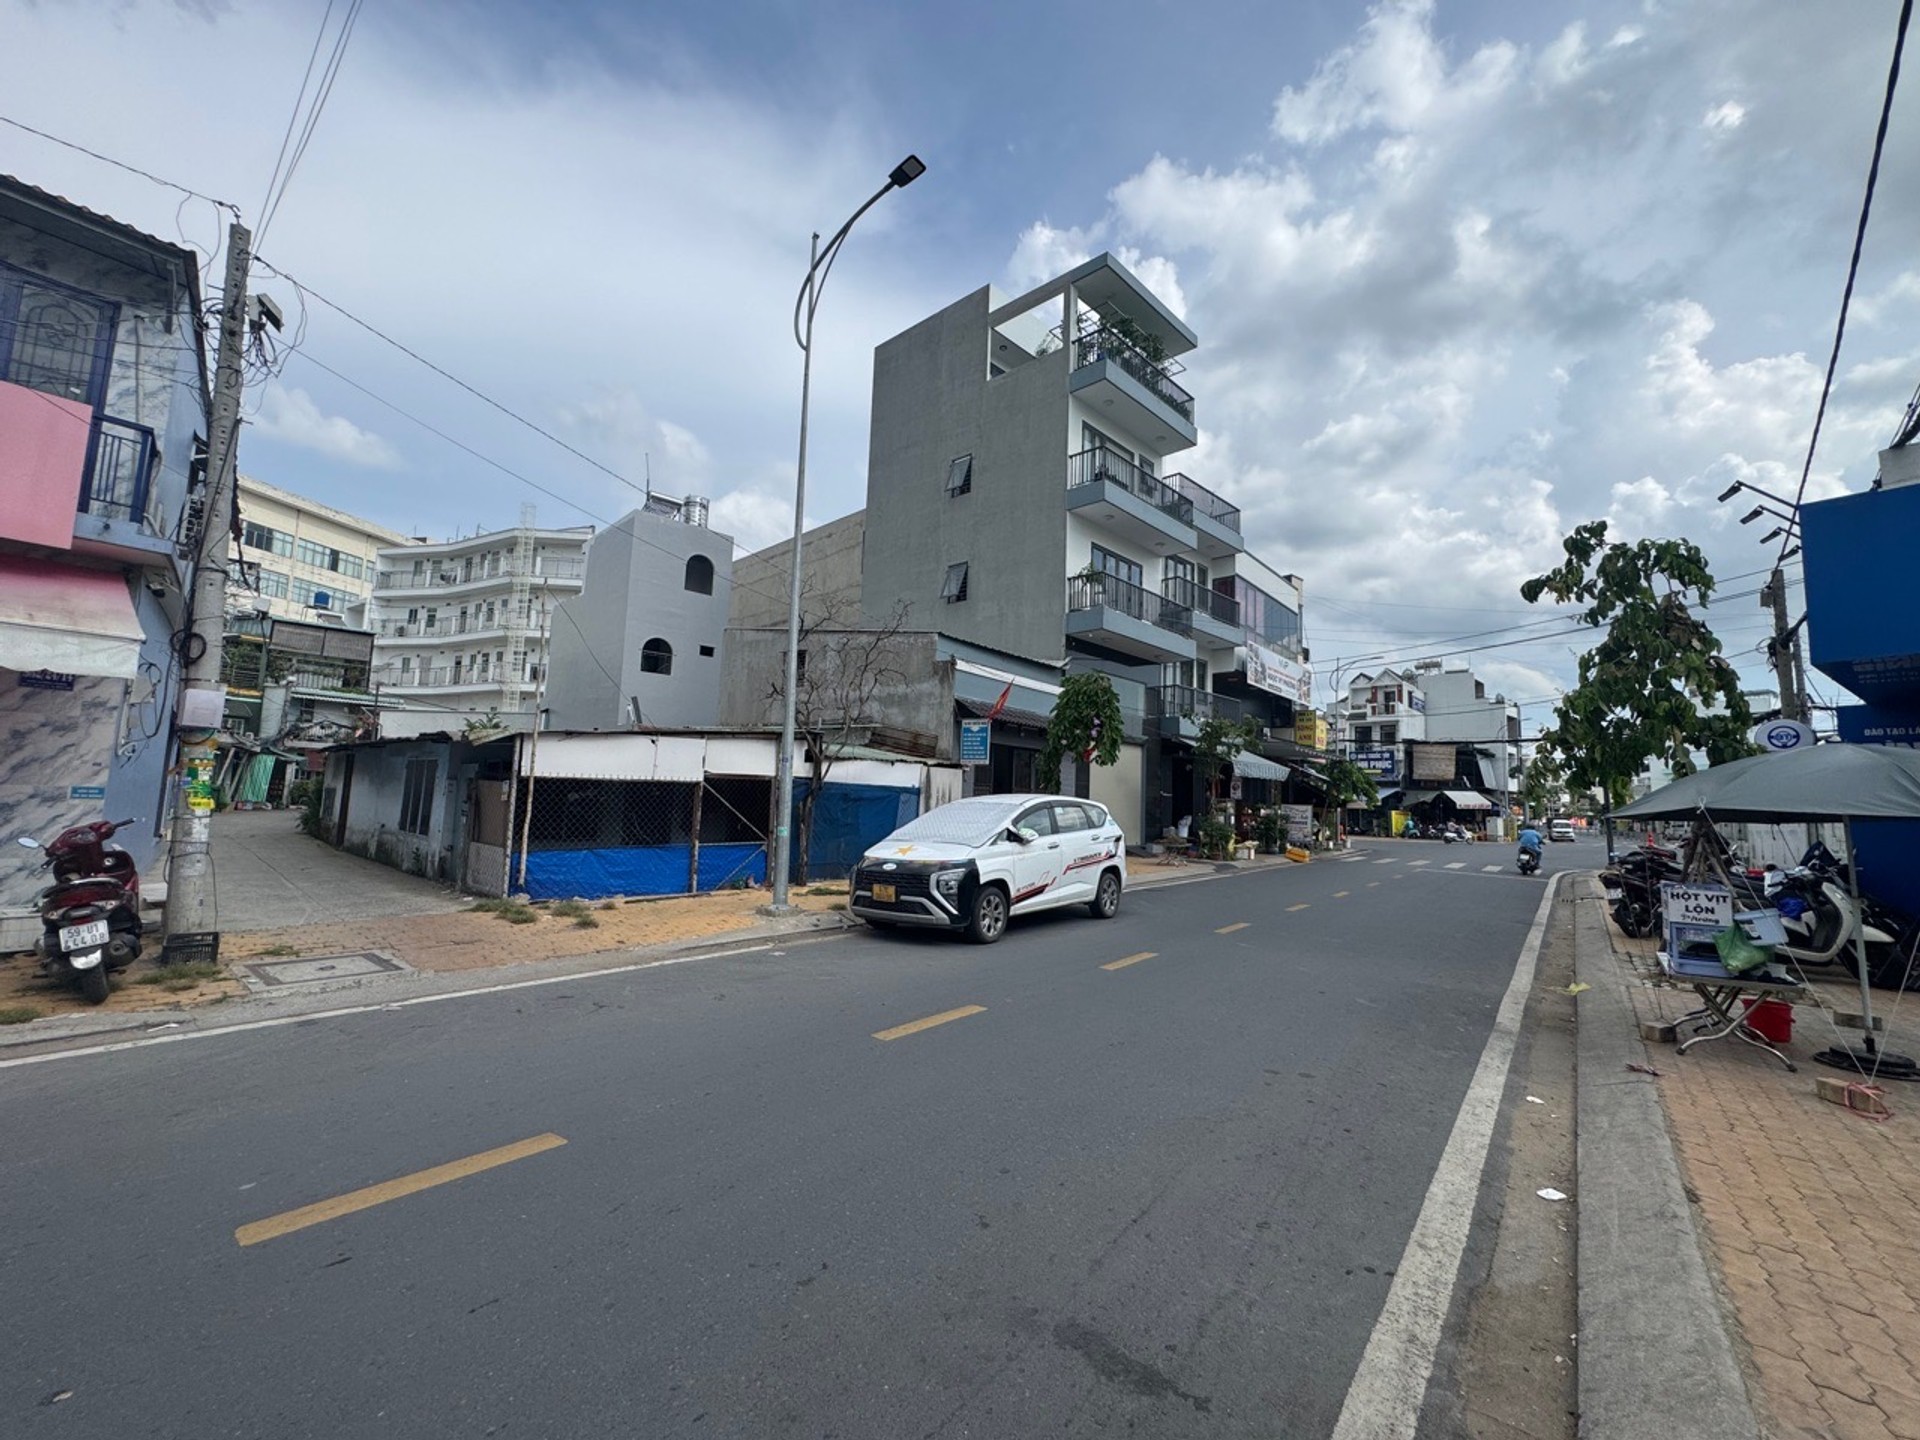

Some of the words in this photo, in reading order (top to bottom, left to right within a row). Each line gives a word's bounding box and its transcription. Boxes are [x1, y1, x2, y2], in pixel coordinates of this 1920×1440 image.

[1670, 890, 1701, 903] HỘT
[1704, 893, 1729, 906] VỊT
[1684, 903, 1716, 916] LỘN
